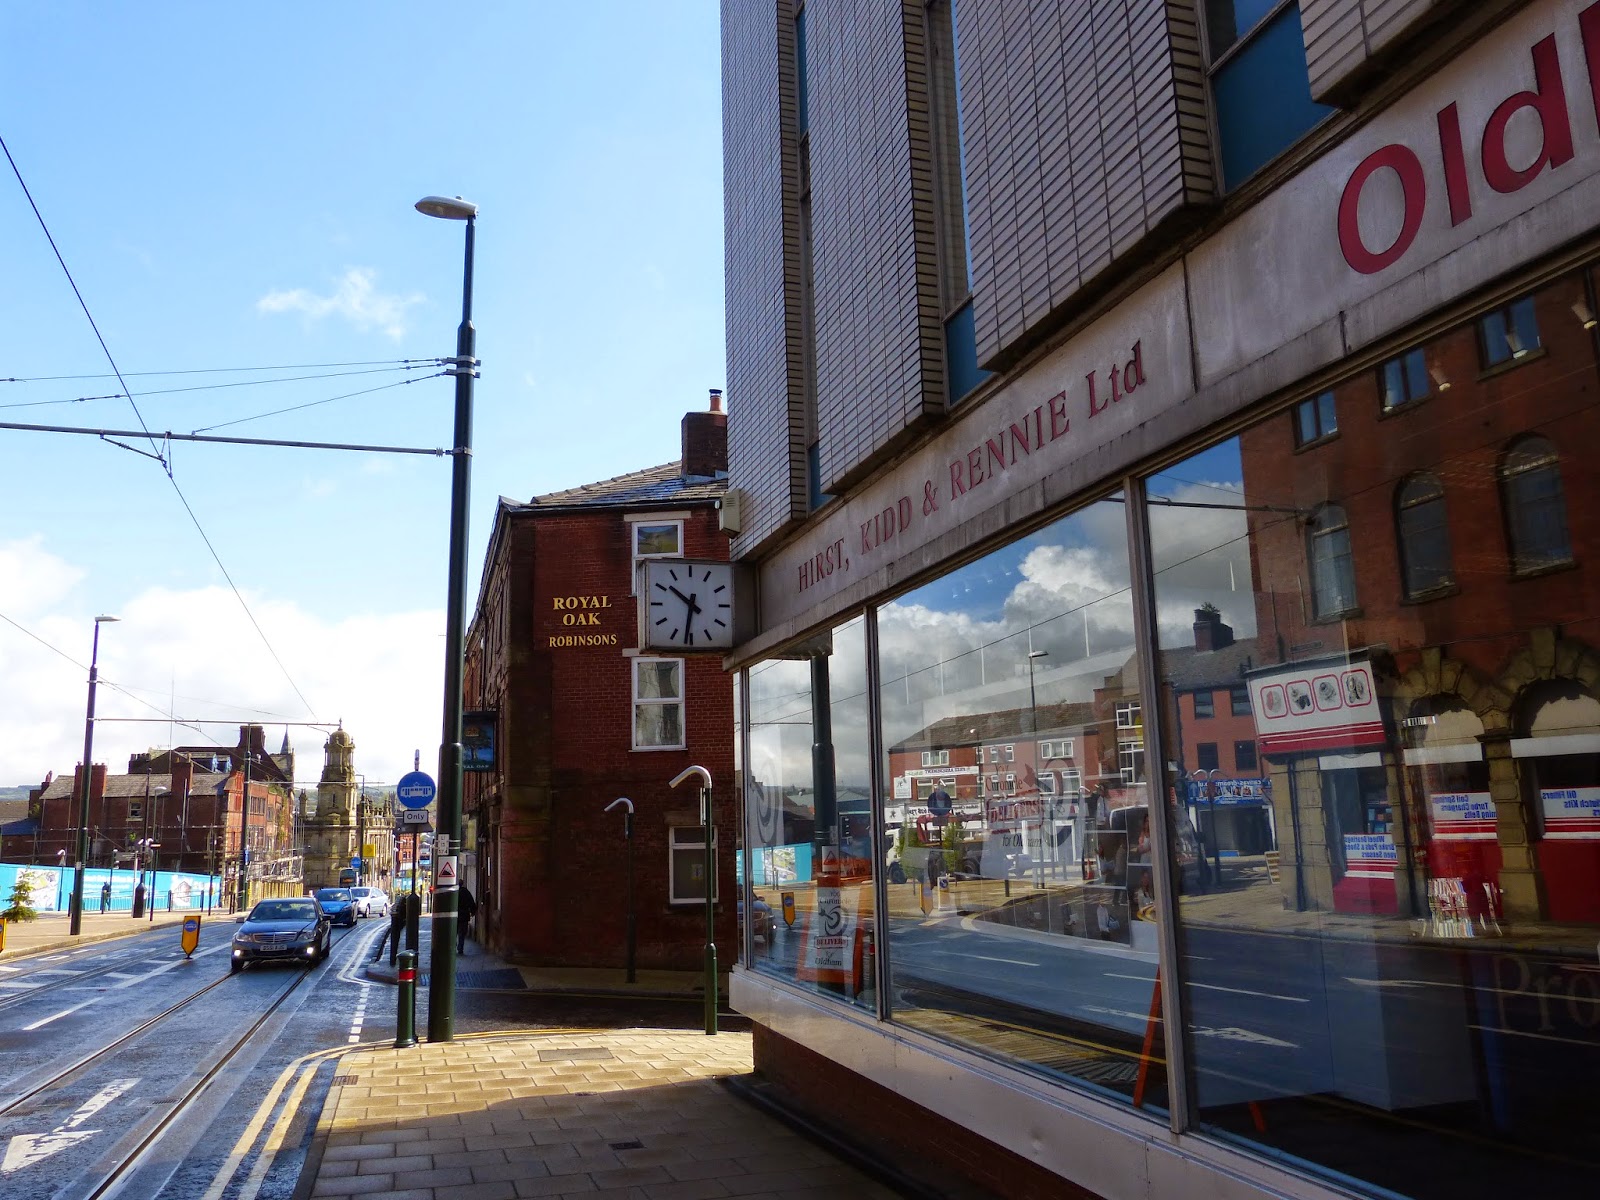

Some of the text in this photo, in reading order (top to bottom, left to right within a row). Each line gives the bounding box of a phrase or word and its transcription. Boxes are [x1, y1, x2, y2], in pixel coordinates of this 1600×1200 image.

[1338, 0, 1600, 275] Old
[797, 339, 1147, 594] HIRST, KIDD & RENNIE Ltd
[552, 595, 613, 610] ROYAL
[562, 612, 602, 626] OAK
[549, 634, 618, 648] ROBINSONS
[406, 813, 425, 821] Only
